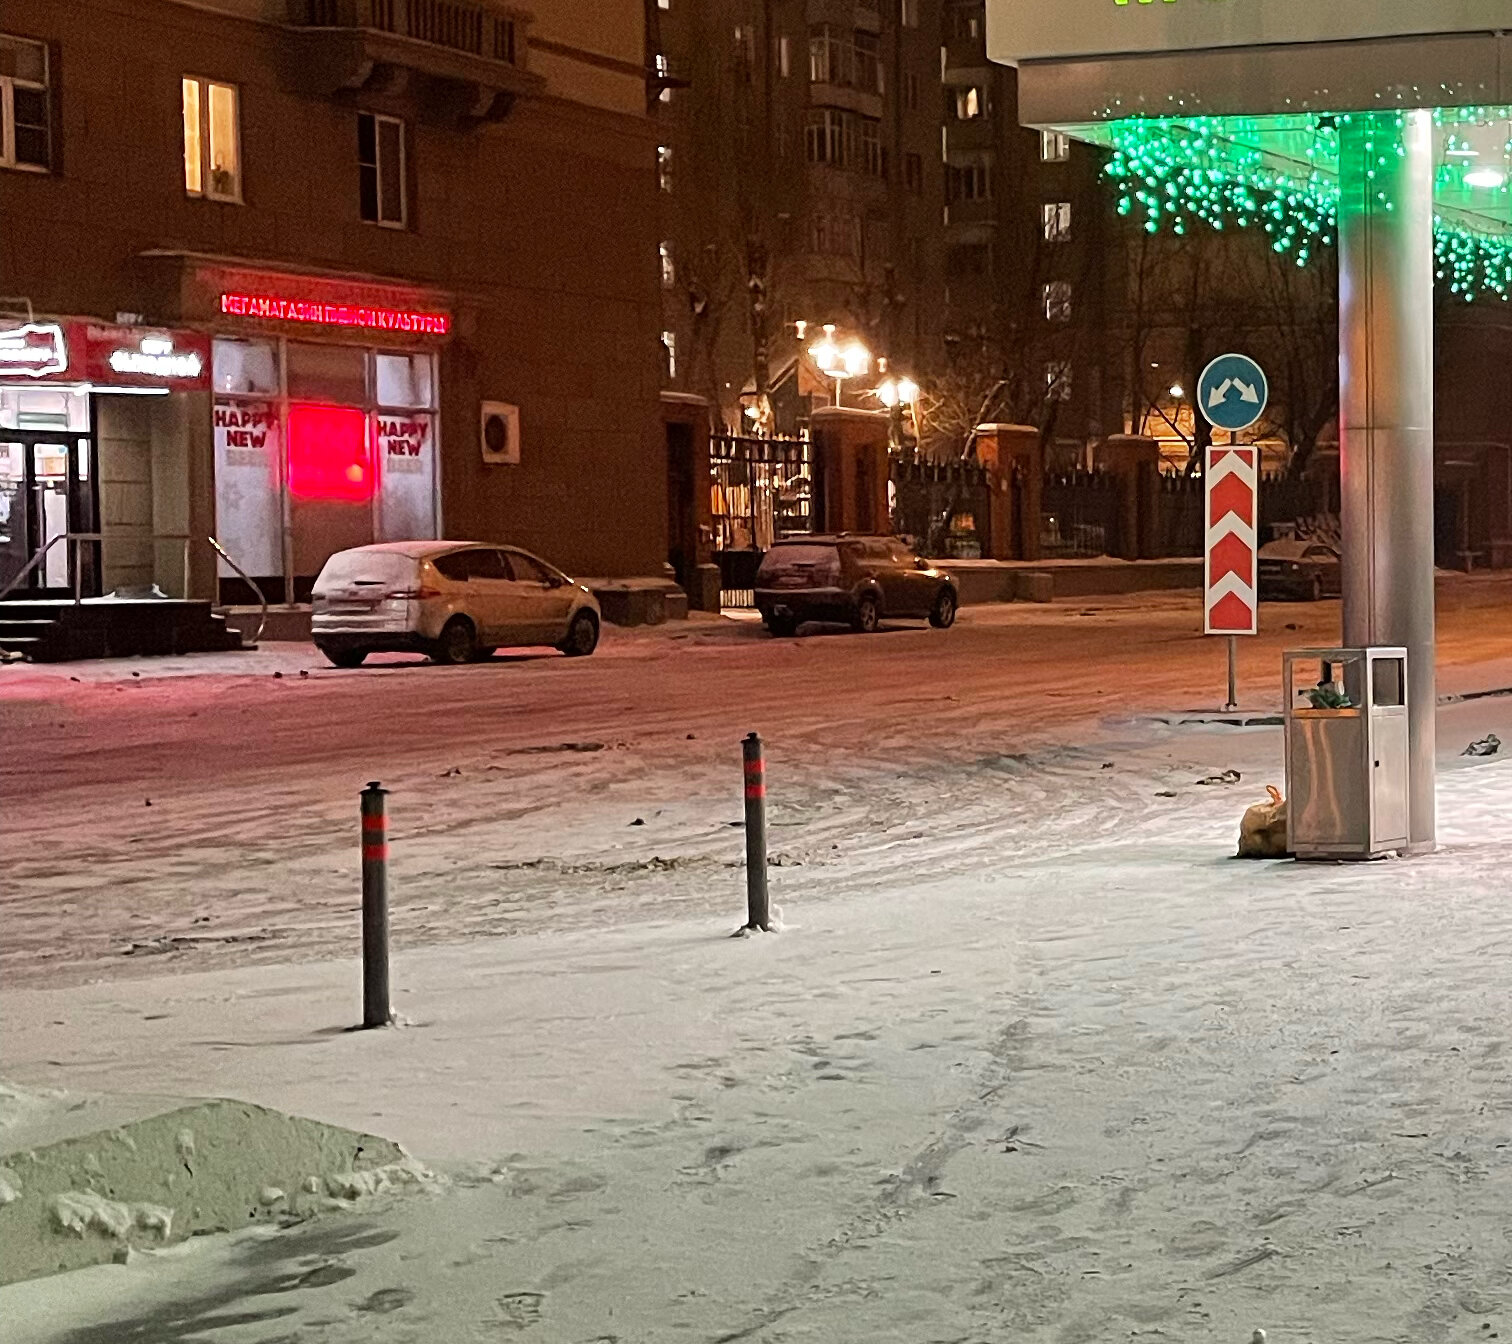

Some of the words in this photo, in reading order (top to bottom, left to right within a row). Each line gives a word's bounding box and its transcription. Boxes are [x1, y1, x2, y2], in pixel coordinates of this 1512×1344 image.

[214, 409, 280, 430] HAPPY
[377, 420, 428, 438] HAPPY
[226, 429, 267, 449] NEW
[387, 439, 422, 457] NEW
